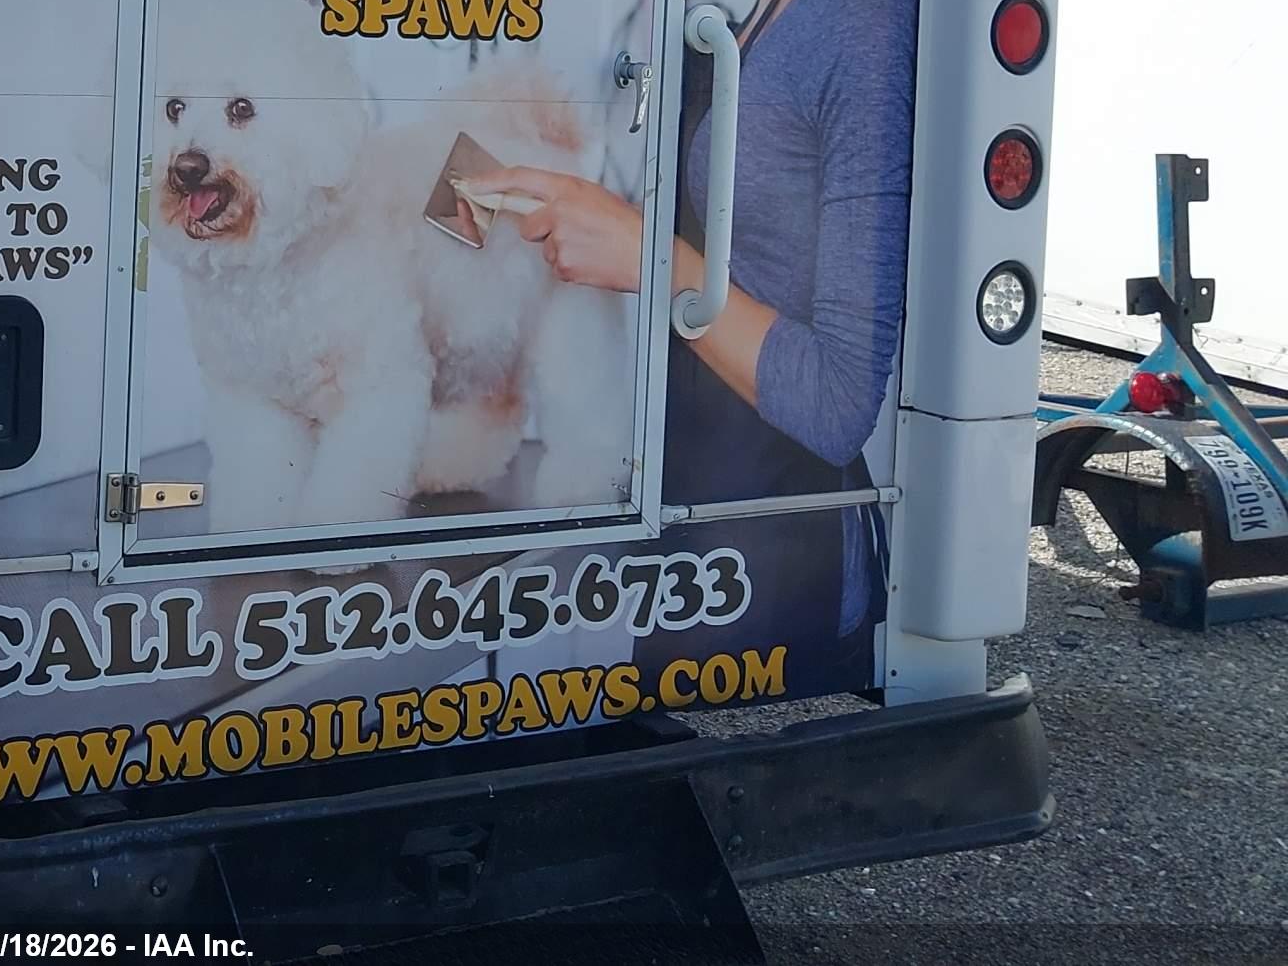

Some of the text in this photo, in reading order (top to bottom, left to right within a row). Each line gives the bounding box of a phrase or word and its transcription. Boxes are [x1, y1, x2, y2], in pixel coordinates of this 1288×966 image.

[6, 202, 68, 236] TO
[1242, 459, 1275, 499] TEXAS
[237, 550, 750, 679] 512.645.6733
